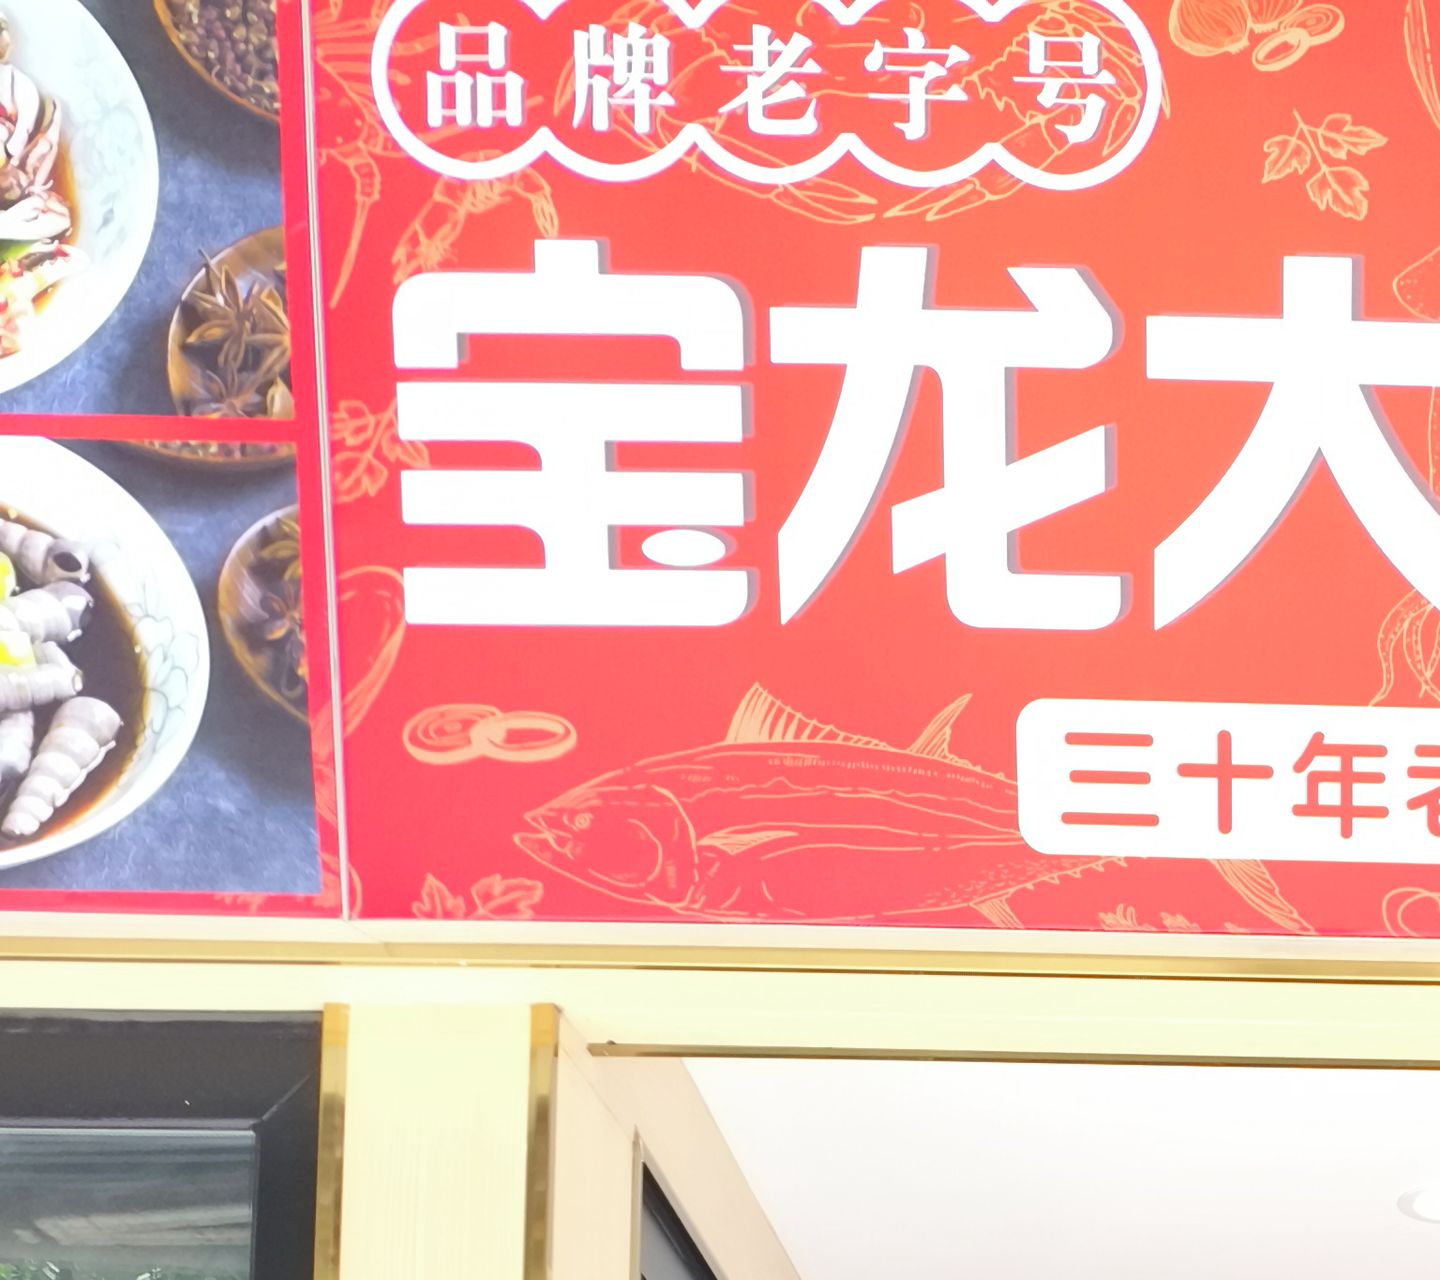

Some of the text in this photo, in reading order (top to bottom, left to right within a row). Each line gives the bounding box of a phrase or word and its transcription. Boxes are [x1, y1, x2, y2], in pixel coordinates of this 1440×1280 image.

[425, 22, 1120, 144] 品牌老字号
